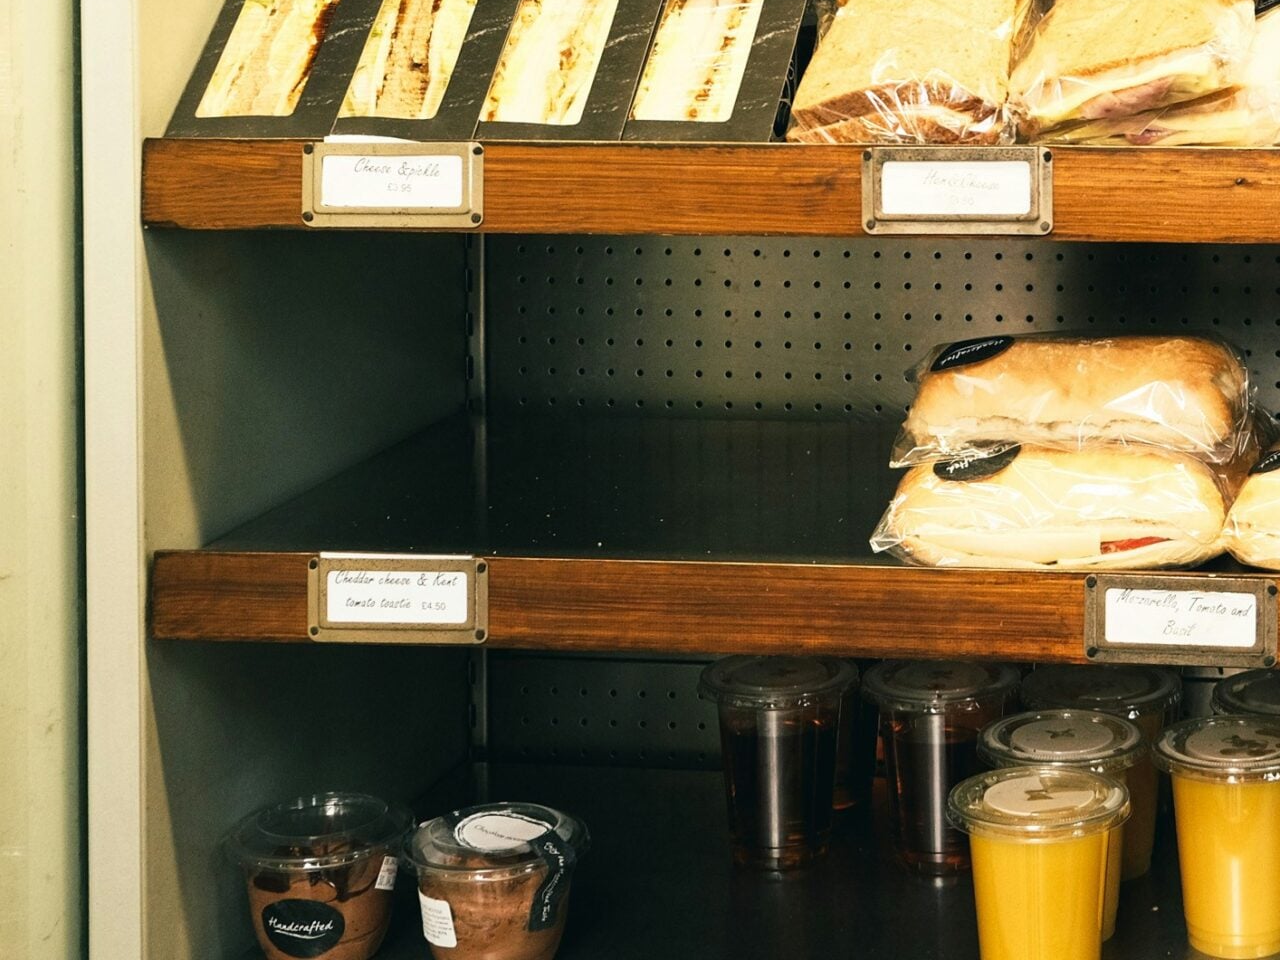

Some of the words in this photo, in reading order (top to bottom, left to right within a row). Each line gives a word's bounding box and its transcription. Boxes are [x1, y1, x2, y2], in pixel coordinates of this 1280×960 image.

[354, 157, 392, 174] Cheese
[335, 570, 374, 585] Cheddar
[378, 572, 411, 585] cheese
[416, 573, 428, 587] &
[432, 572, 458, 587] Kent
[345, 596, 376, 608] tomato
[380, 598, 412, 609] toastie
[421, 601, 447, 611] £4.50
[1188, 596, 1227, 614] Tomato
[1231, 604, 1253, 617] and
[268, 916, 334, 935] Handcrafted
